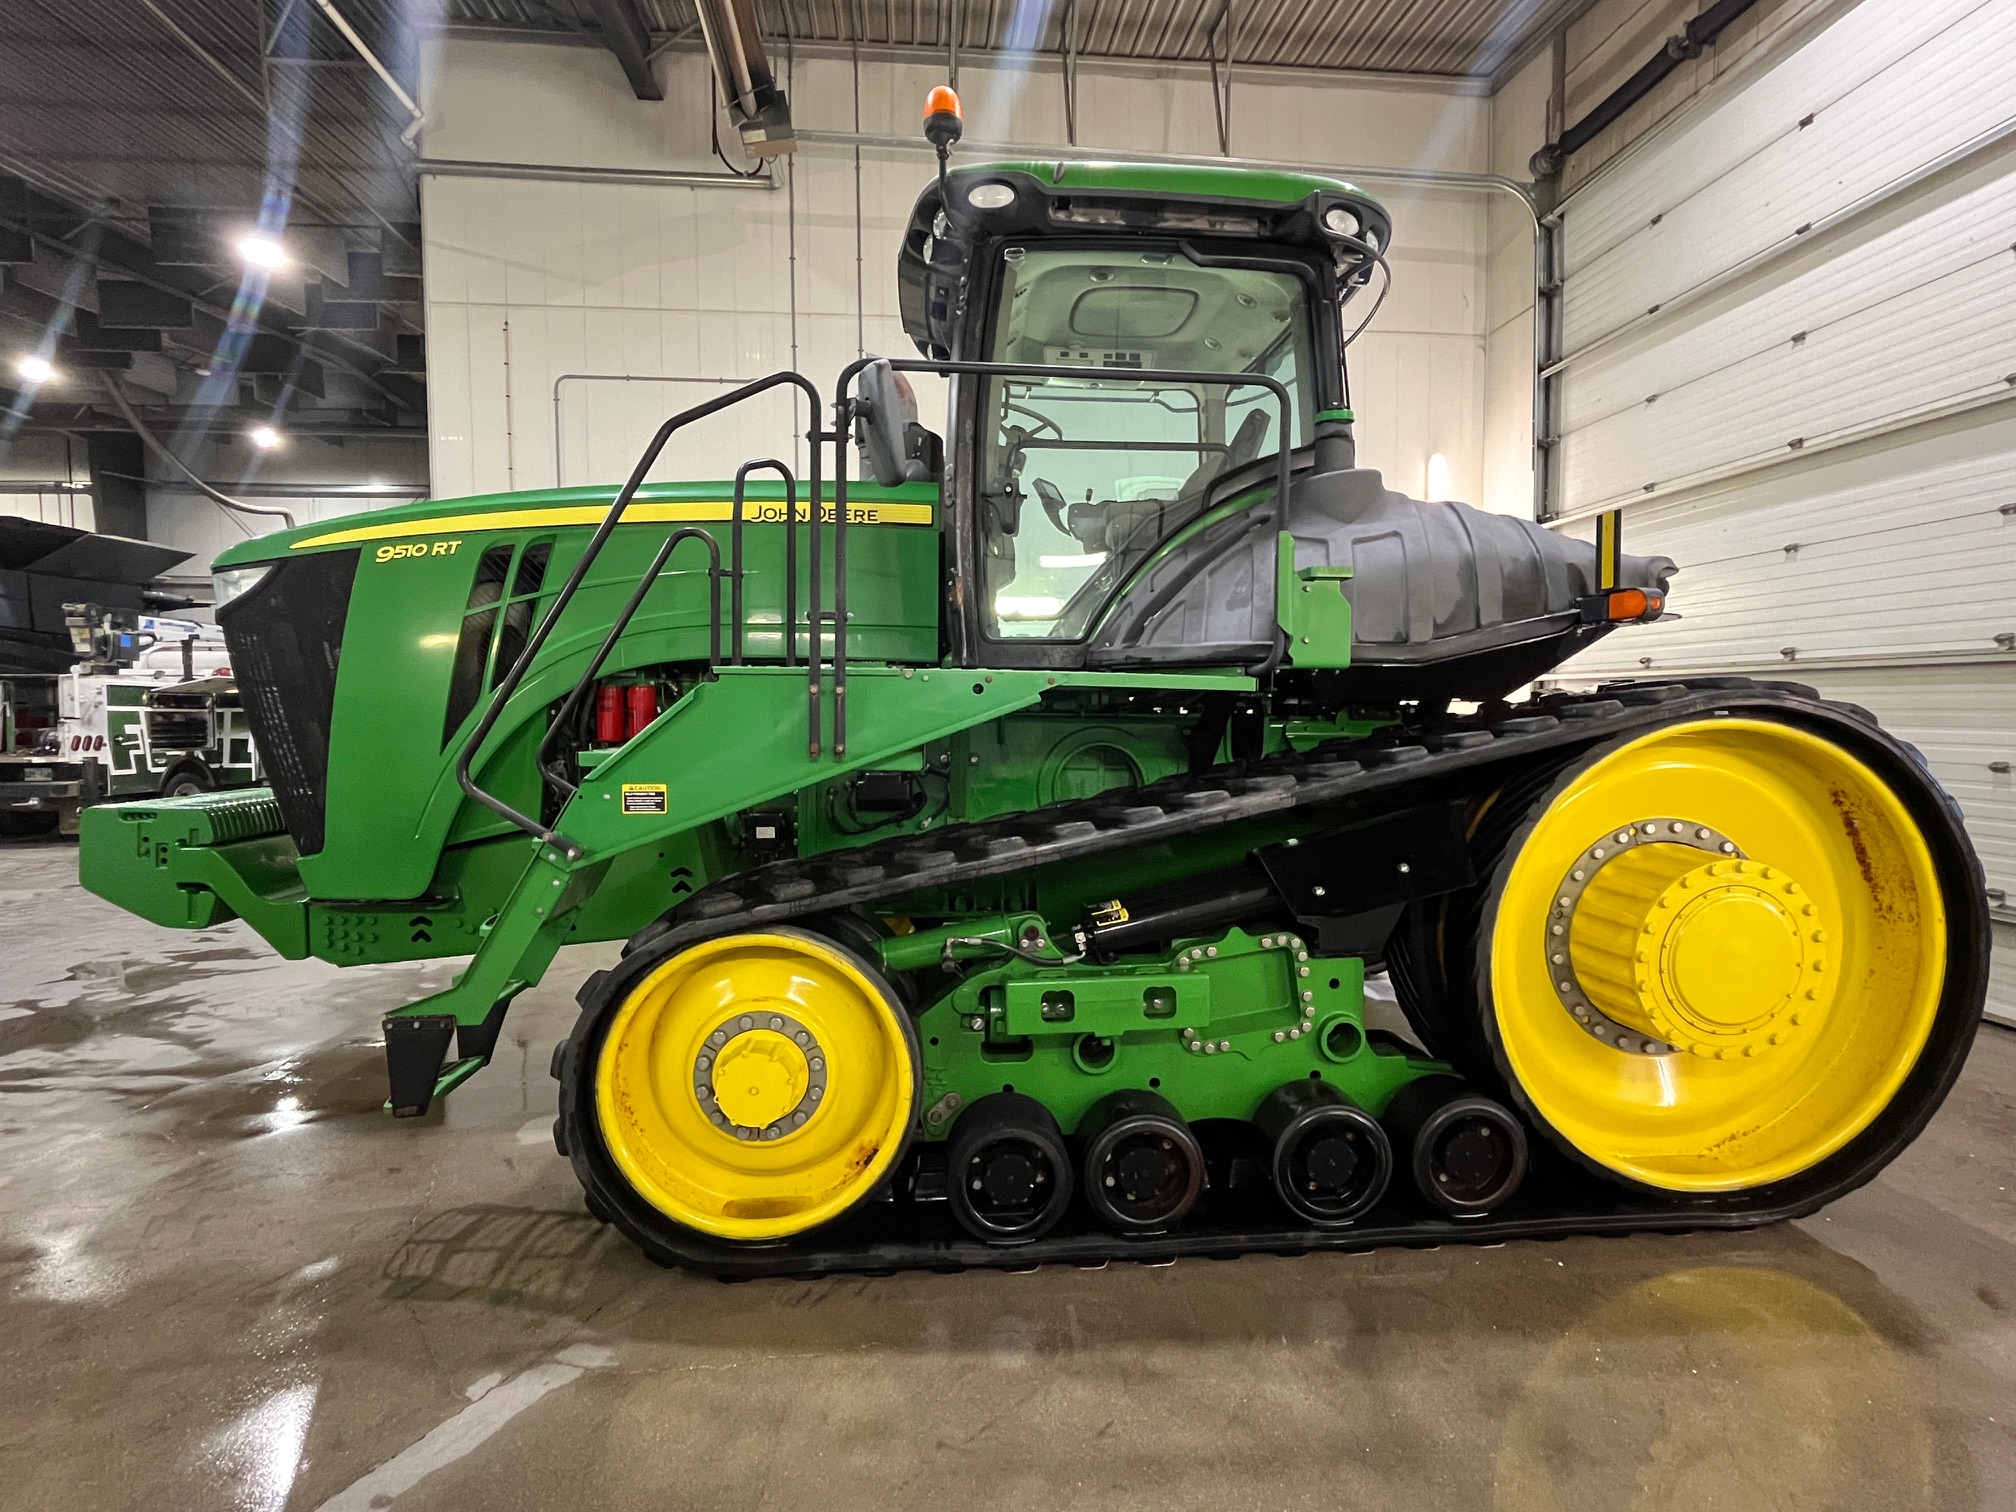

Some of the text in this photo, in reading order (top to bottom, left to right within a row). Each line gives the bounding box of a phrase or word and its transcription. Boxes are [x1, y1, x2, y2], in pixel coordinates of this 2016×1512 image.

[751, 505, 806, 520] JOHN
[375, 540, 463, 563] 9510 RT
